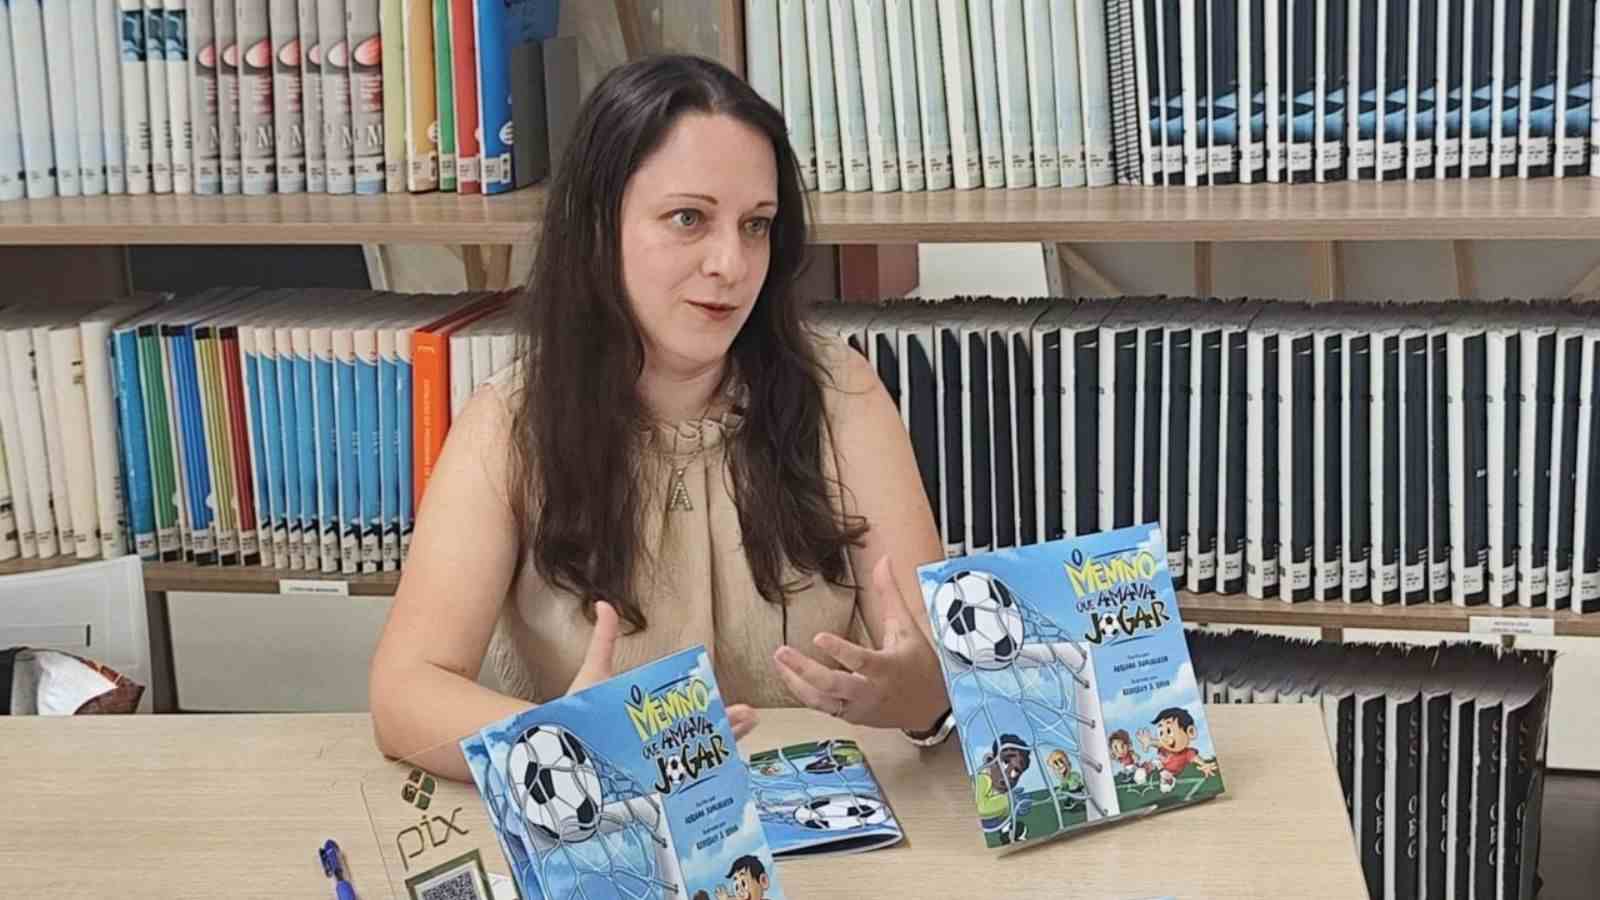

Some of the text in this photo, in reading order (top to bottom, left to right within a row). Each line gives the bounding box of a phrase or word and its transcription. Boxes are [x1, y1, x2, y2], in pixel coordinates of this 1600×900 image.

[1064, 551, 1156, 599] MENINO
[1071, 548, 1083, 567] O
[1097, 583, 1156, 608] AMAVA
[624, 678, 709, 742] MENINO
[630, 684, 642, 705] O
[662, 715, 715, 750] AMAVA
[395, 807, 471, 873] pix
